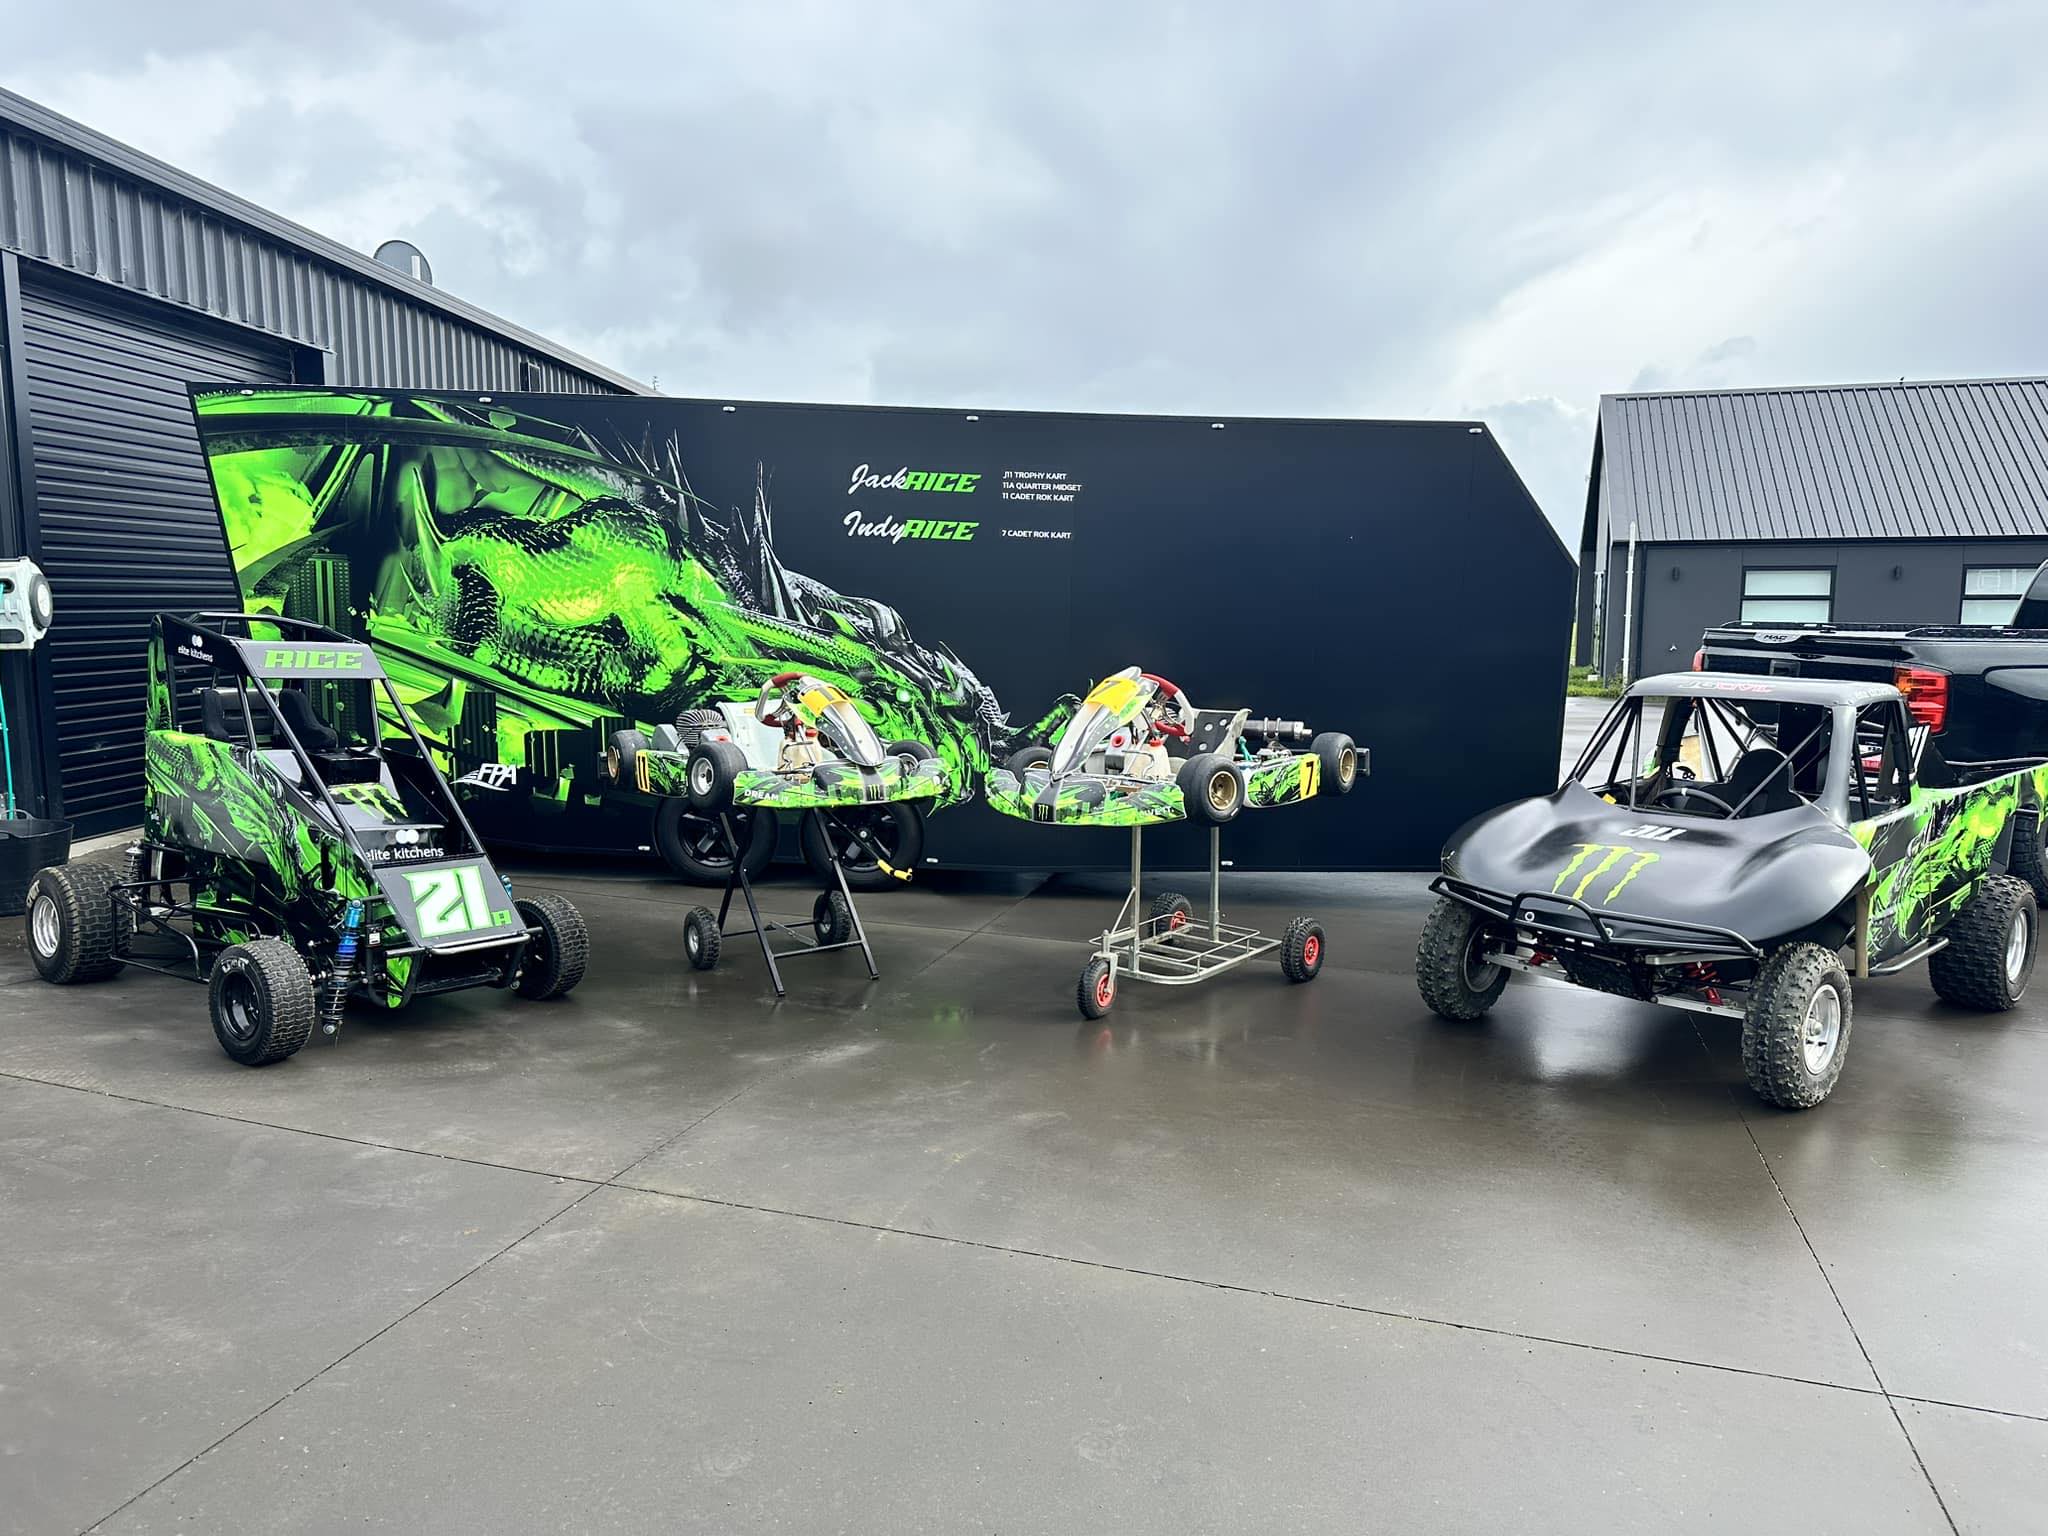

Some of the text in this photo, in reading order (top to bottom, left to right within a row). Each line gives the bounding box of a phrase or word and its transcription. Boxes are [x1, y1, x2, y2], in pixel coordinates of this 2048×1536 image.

[1014, 471, 1045, 480] TROPHY
[1046, 472, 1067, 481] KART
[1002, 482, 1082, 492] 11A QUARTER MIDGET
[1002, 492, 1009, 500] 11
[1010, 493, 1035, 501] CADET
[1053, 494, 1074, 502] KART
[1002, 529, 1072, 540] 7 CADET ROK KART
[178, 645, 213, 663] elite kitchens
[264, 650, 363, 670] RICE
[477, 763, 517, 787] FPA
[1306, 761, 1314, 796] 7
[744, 789, 779, 802] DREAM
[366, 847, 445, 861] elite kitchens
[401, 865, 496, 939] 21
